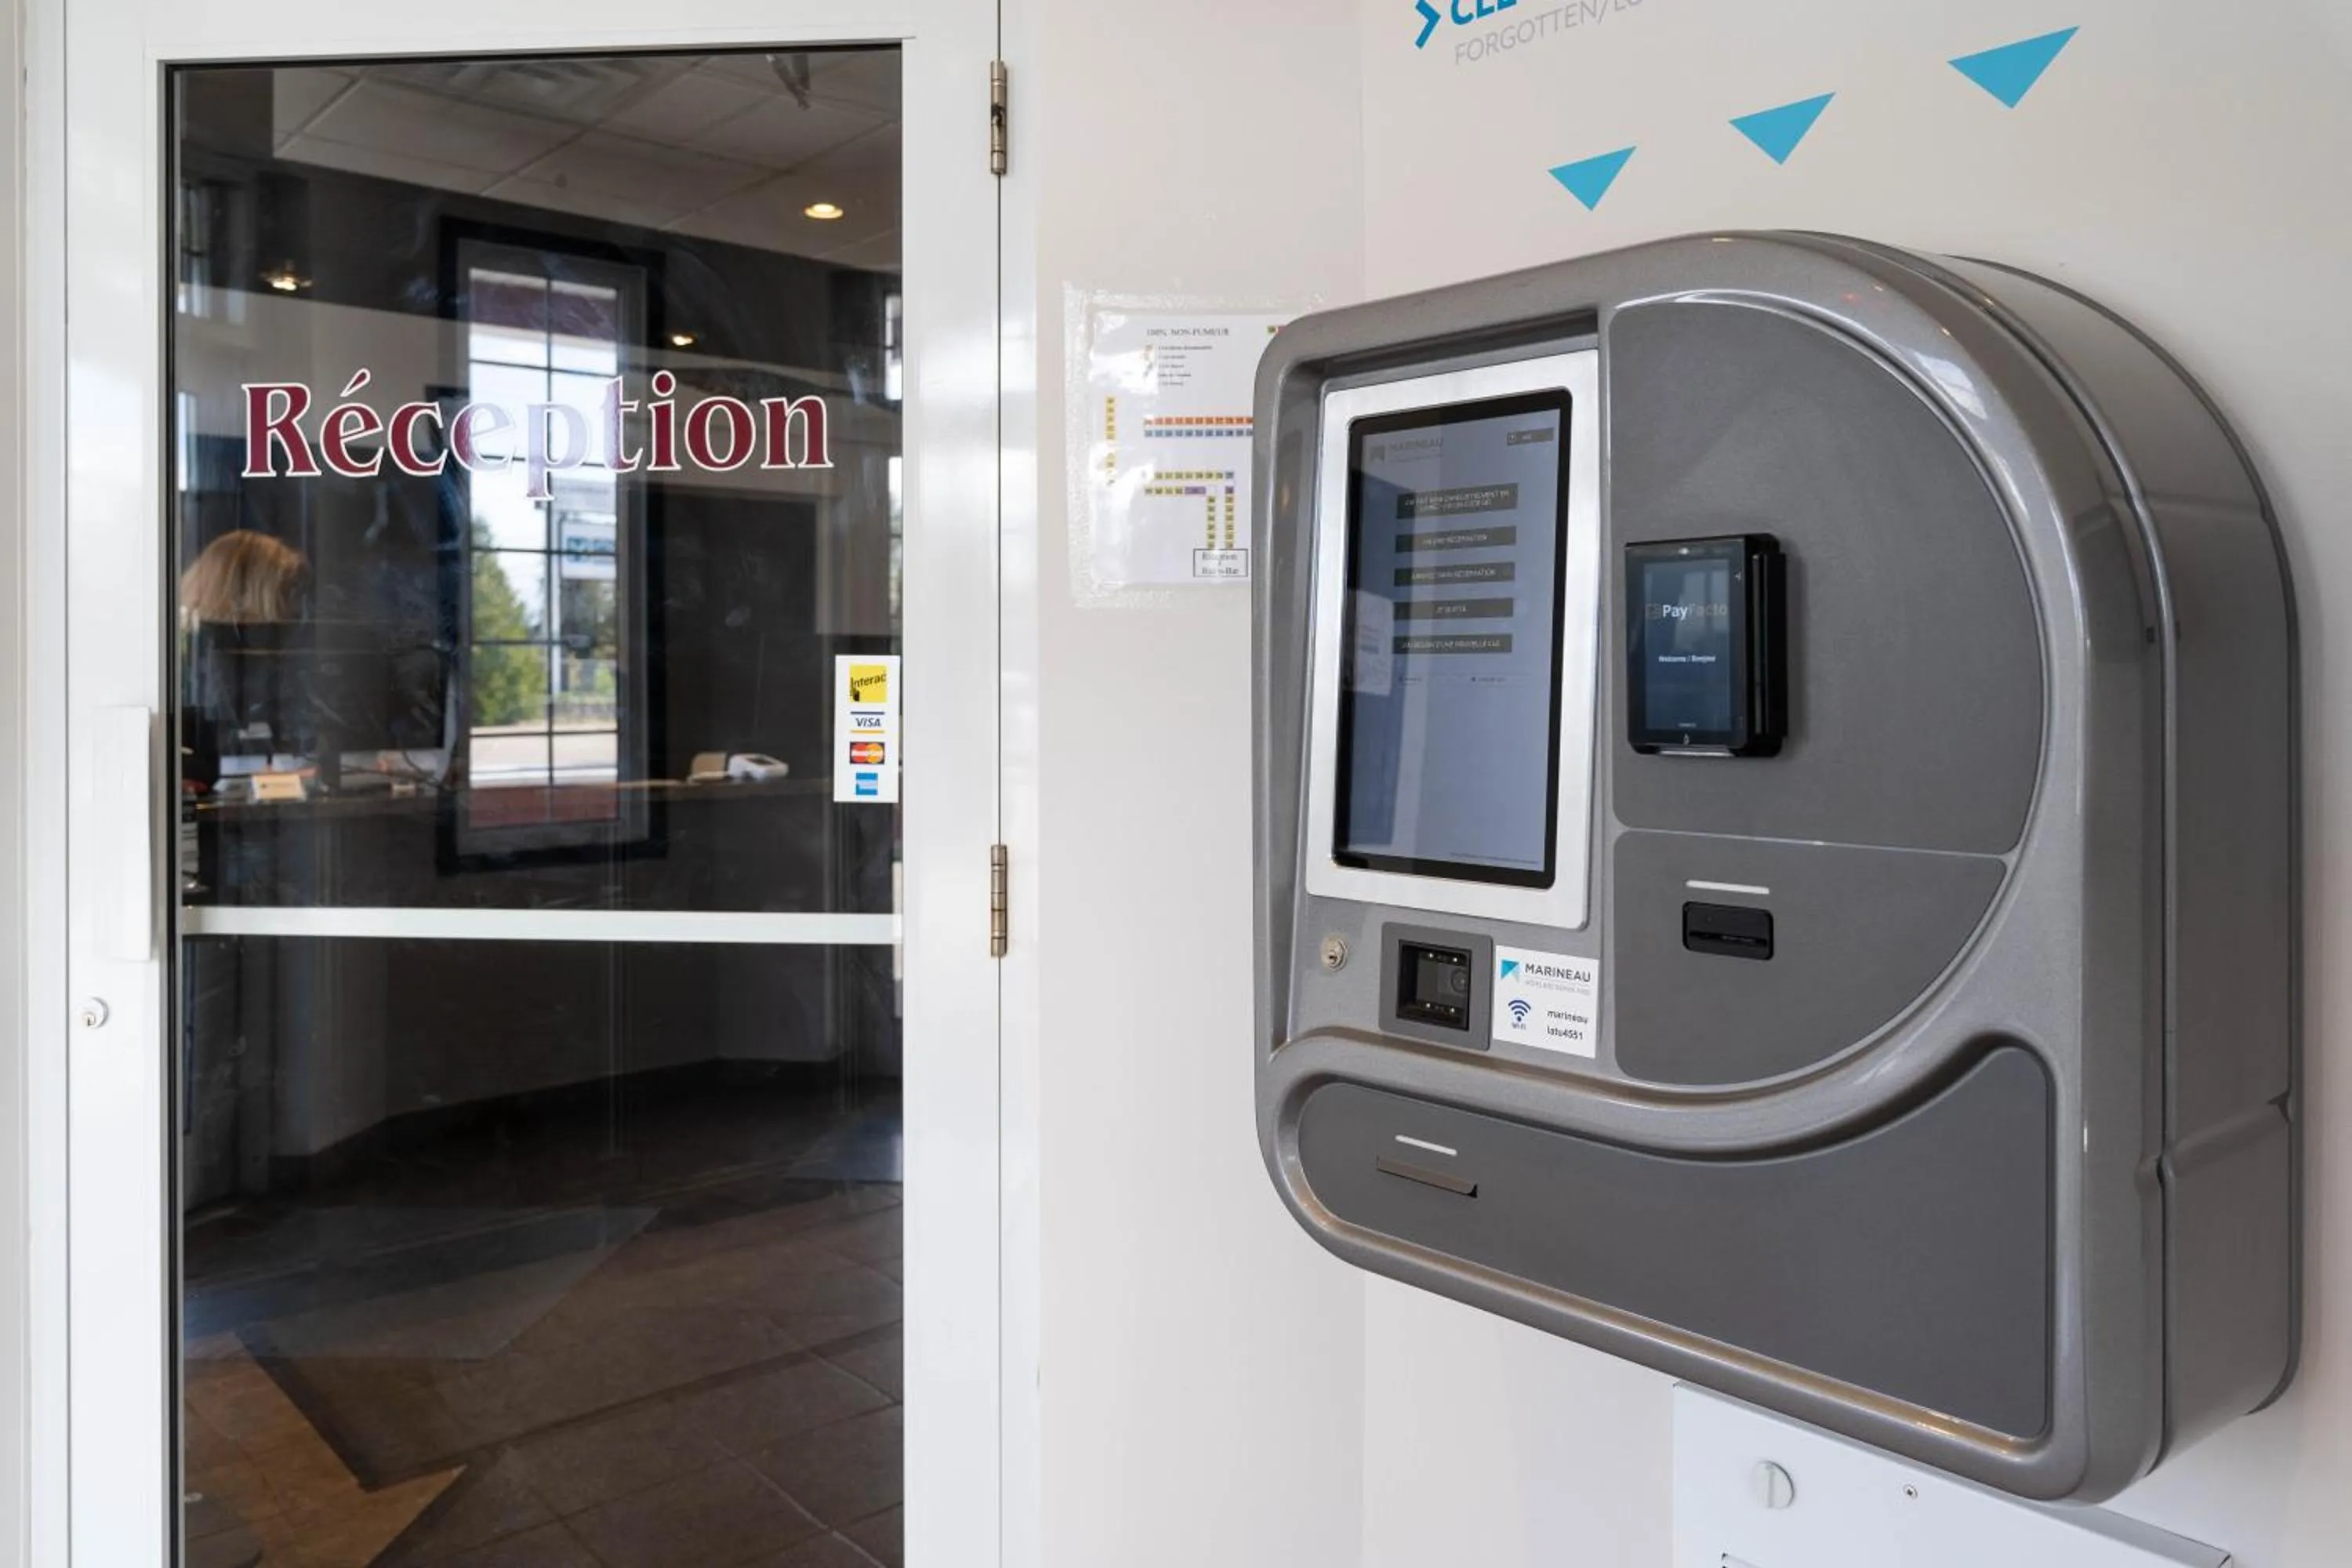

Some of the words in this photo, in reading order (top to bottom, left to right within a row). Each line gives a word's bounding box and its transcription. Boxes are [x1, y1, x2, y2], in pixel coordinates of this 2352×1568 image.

[1454, 0, 1643, 65] FORGOTTEN/L
[241, 368, 834, 501] Réception
[851, 673, 887, 691] Interac
[855, 717, 881, 728] VISA
[1525, 963, 1592, 982] MARINEAU
[1546, 1010, 1588, 1025] marineau
